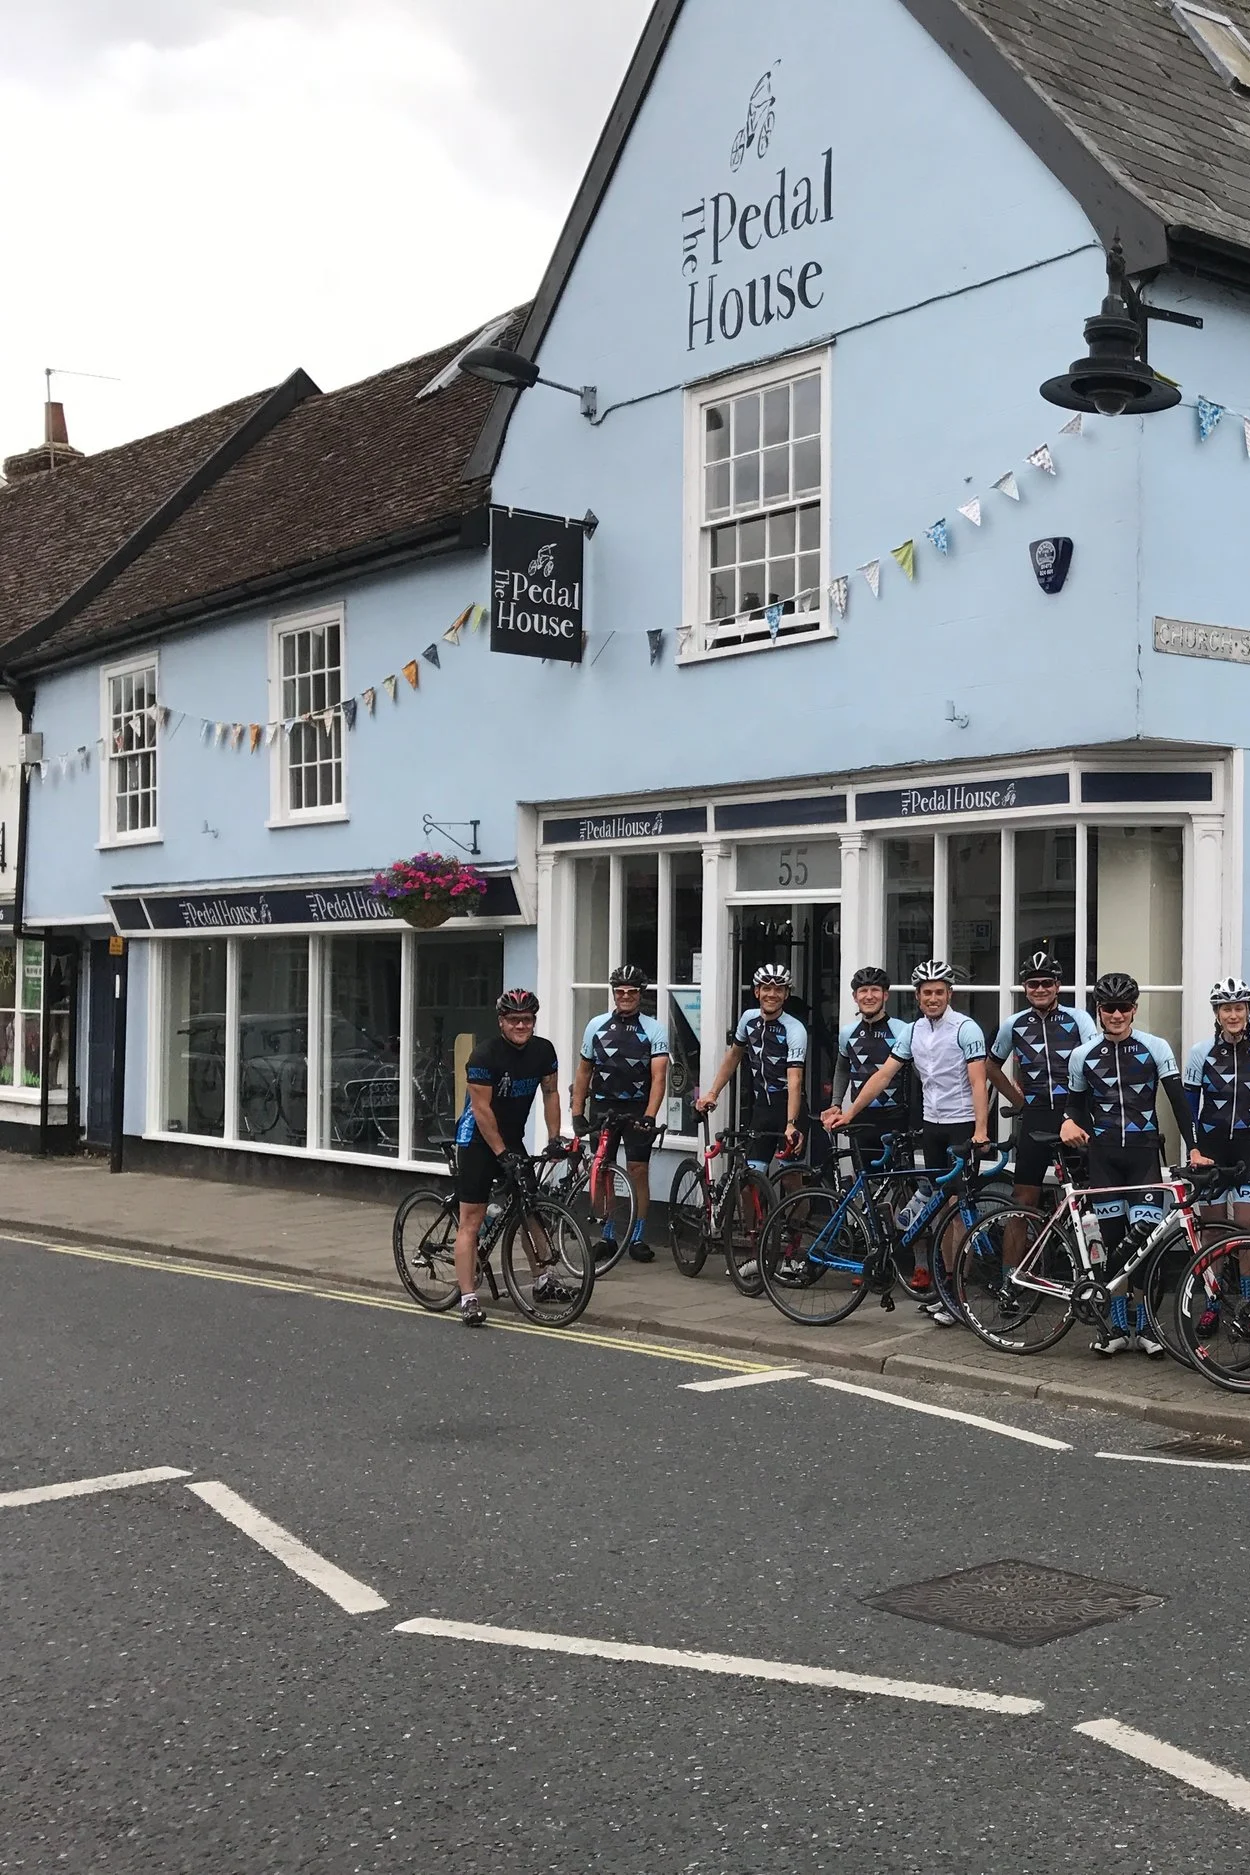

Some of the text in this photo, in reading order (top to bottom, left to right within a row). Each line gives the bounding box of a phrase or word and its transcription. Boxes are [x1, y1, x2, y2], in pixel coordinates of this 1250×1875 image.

[710, 146, 835, 266] Pedal
[681, 197, 706, 278] The
[687, 260, 825, 352] House
[494, 569, 581, 611] The Pedal
[496, 600, 575, 639] House
[1159, 623, 1233, 655] CHURCH
[901, 786, 1001, 816] The Pedal House
[586, 818, 616, 840] Pedal
[617, 817, 651, 838] House
[778, 848, 809, 887] 55
[185, 901, 222, 927] Pedal
[221, 899, 260, 925] House
[314, 891, 358, 921] Pedal
[901, 1190, 945, 1247] RALEIGH
